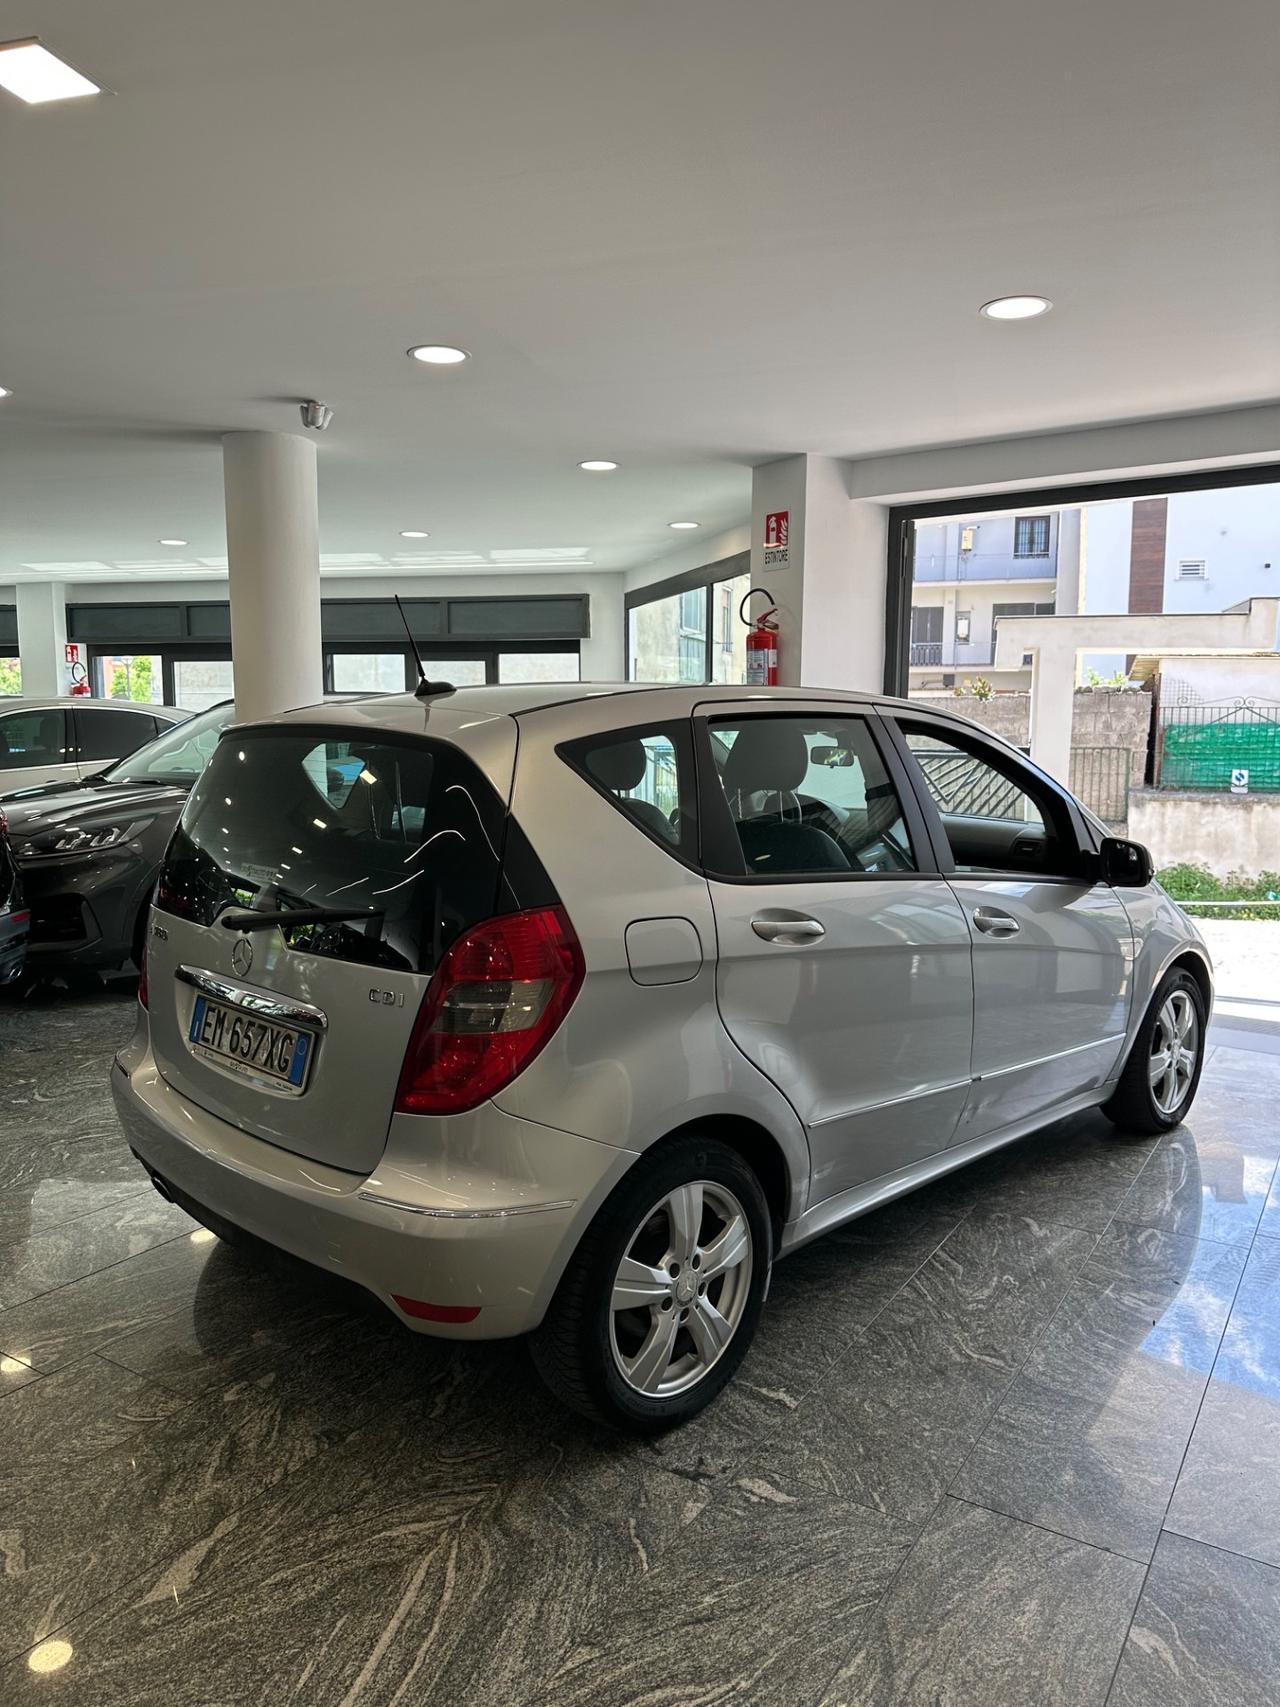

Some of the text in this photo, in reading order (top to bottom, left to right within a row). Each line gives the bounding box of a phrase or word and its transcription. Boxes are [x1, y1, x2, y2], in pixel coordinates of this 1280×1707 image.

[764, 549, 789, 565] ESTINTORE
[368, 988, 405, 1008] CDI
[201, 1005, 294, 1073] EM 657XG
